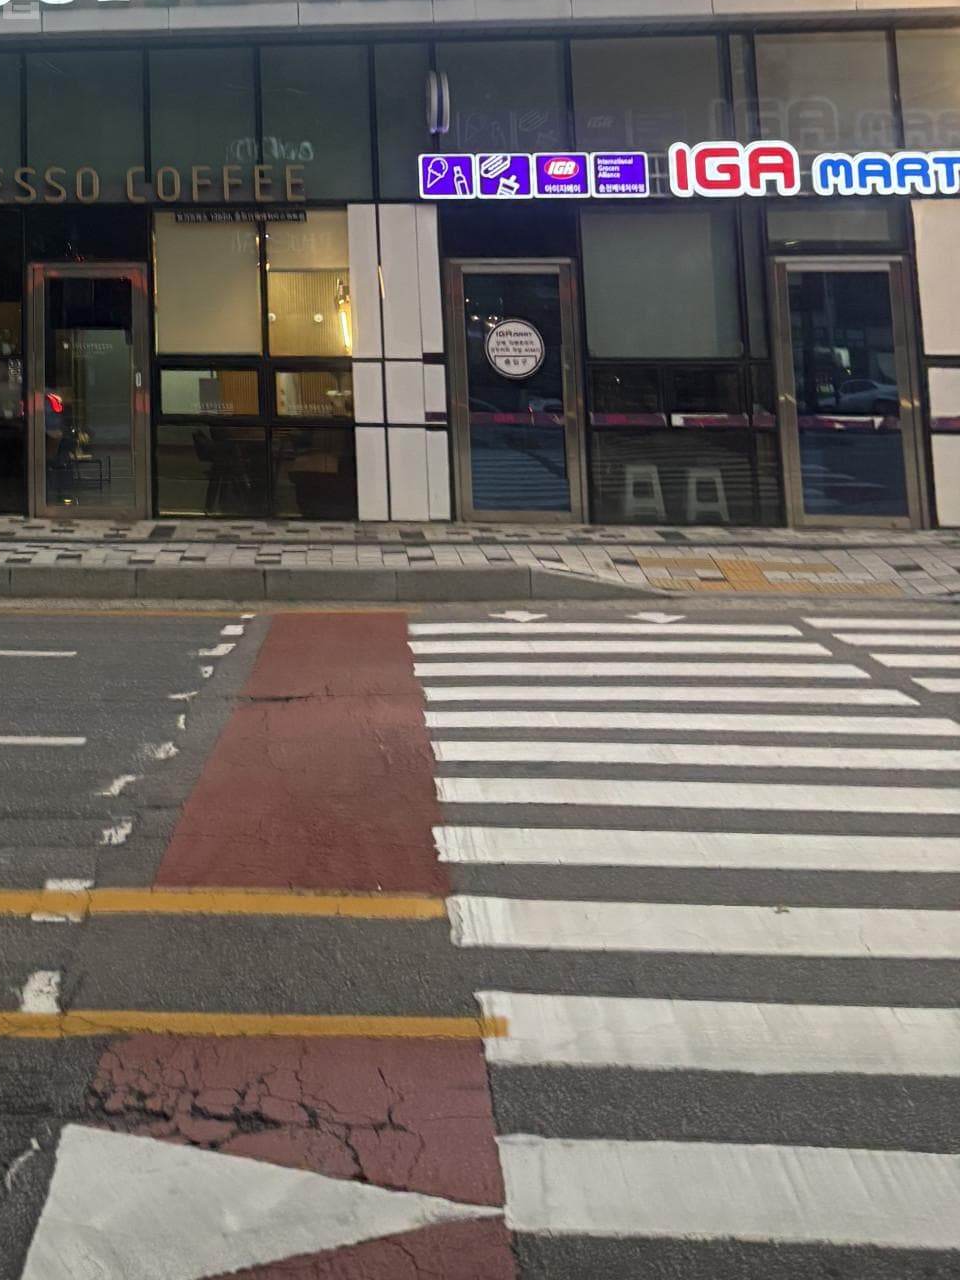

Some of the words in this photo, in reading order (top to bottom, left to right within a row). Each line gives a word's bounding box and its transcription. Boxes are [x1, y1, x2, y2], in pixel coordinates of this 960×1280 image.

[547, 160, 575, 176] IGA
[597, 157, 633, 165] International
[673, 145, 798, 193] IGA
[817, 154, 960, 191] MART
[126, 165, 307, 204] COFFEE
[544, 183, 582, 193] 아이지에이
